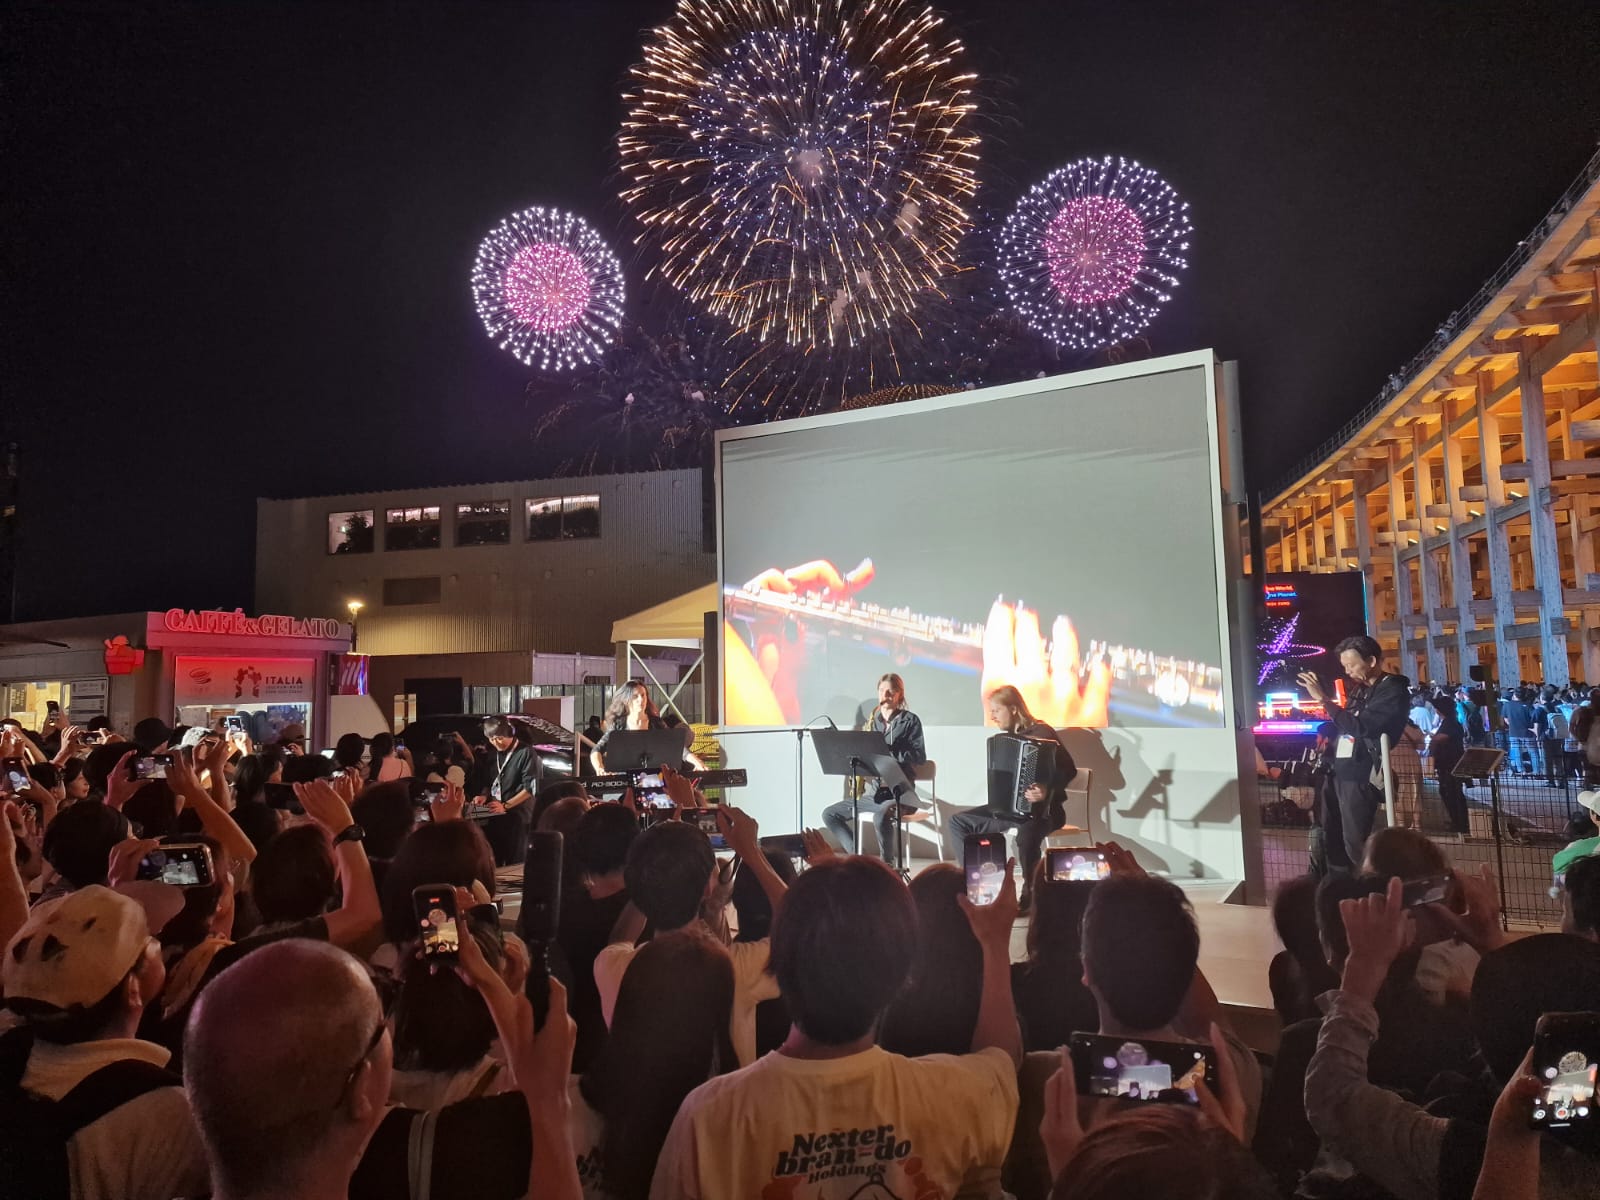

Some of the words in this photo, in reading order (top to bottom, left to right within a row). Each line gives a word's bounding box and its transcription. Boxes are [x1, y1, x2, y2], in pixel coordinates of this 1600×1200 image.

[265, 676, 303, 685] ITALIA
[792, 1124, 894, 1157] Nexter
[808, 1163, 886, 1184] Holdings
